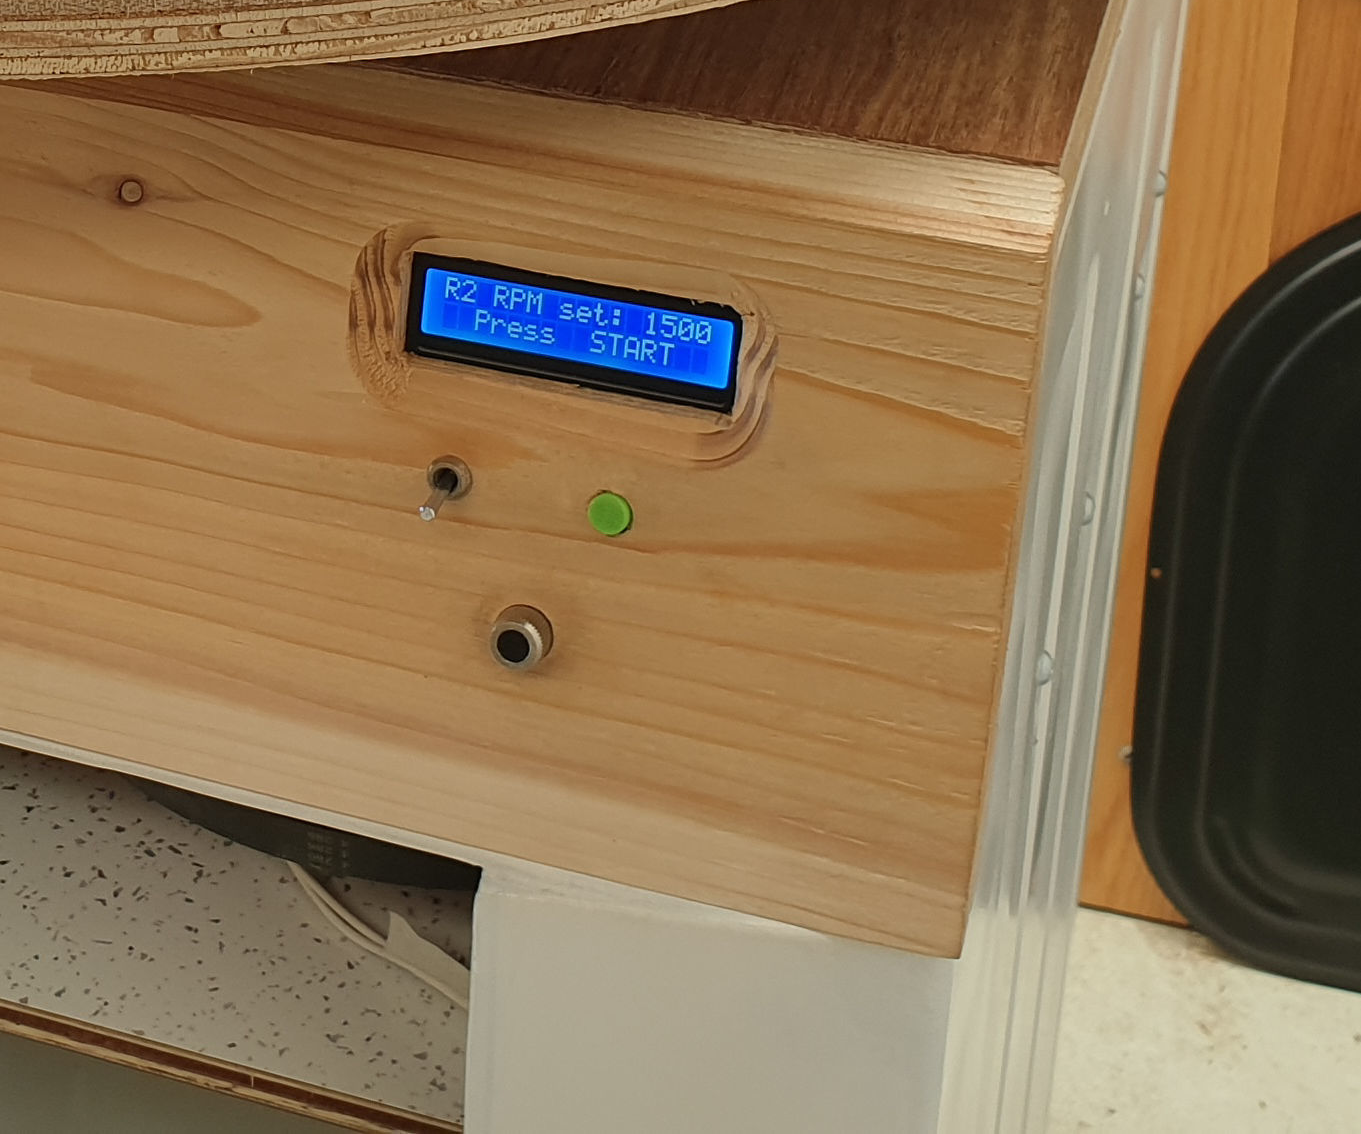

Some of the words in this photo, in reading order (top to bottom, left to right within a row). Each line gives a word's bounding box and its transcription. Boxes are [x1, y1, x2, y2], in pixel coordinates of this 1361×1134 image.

[445, 277, 477, 303] R2
[493, 286, 543, 315] RPM
[559, 303, 622, 326] set:
[646, 313, 712, 345] 1500
[475, 309, 555, 345] Press
[590, 331, 675, 366] START
